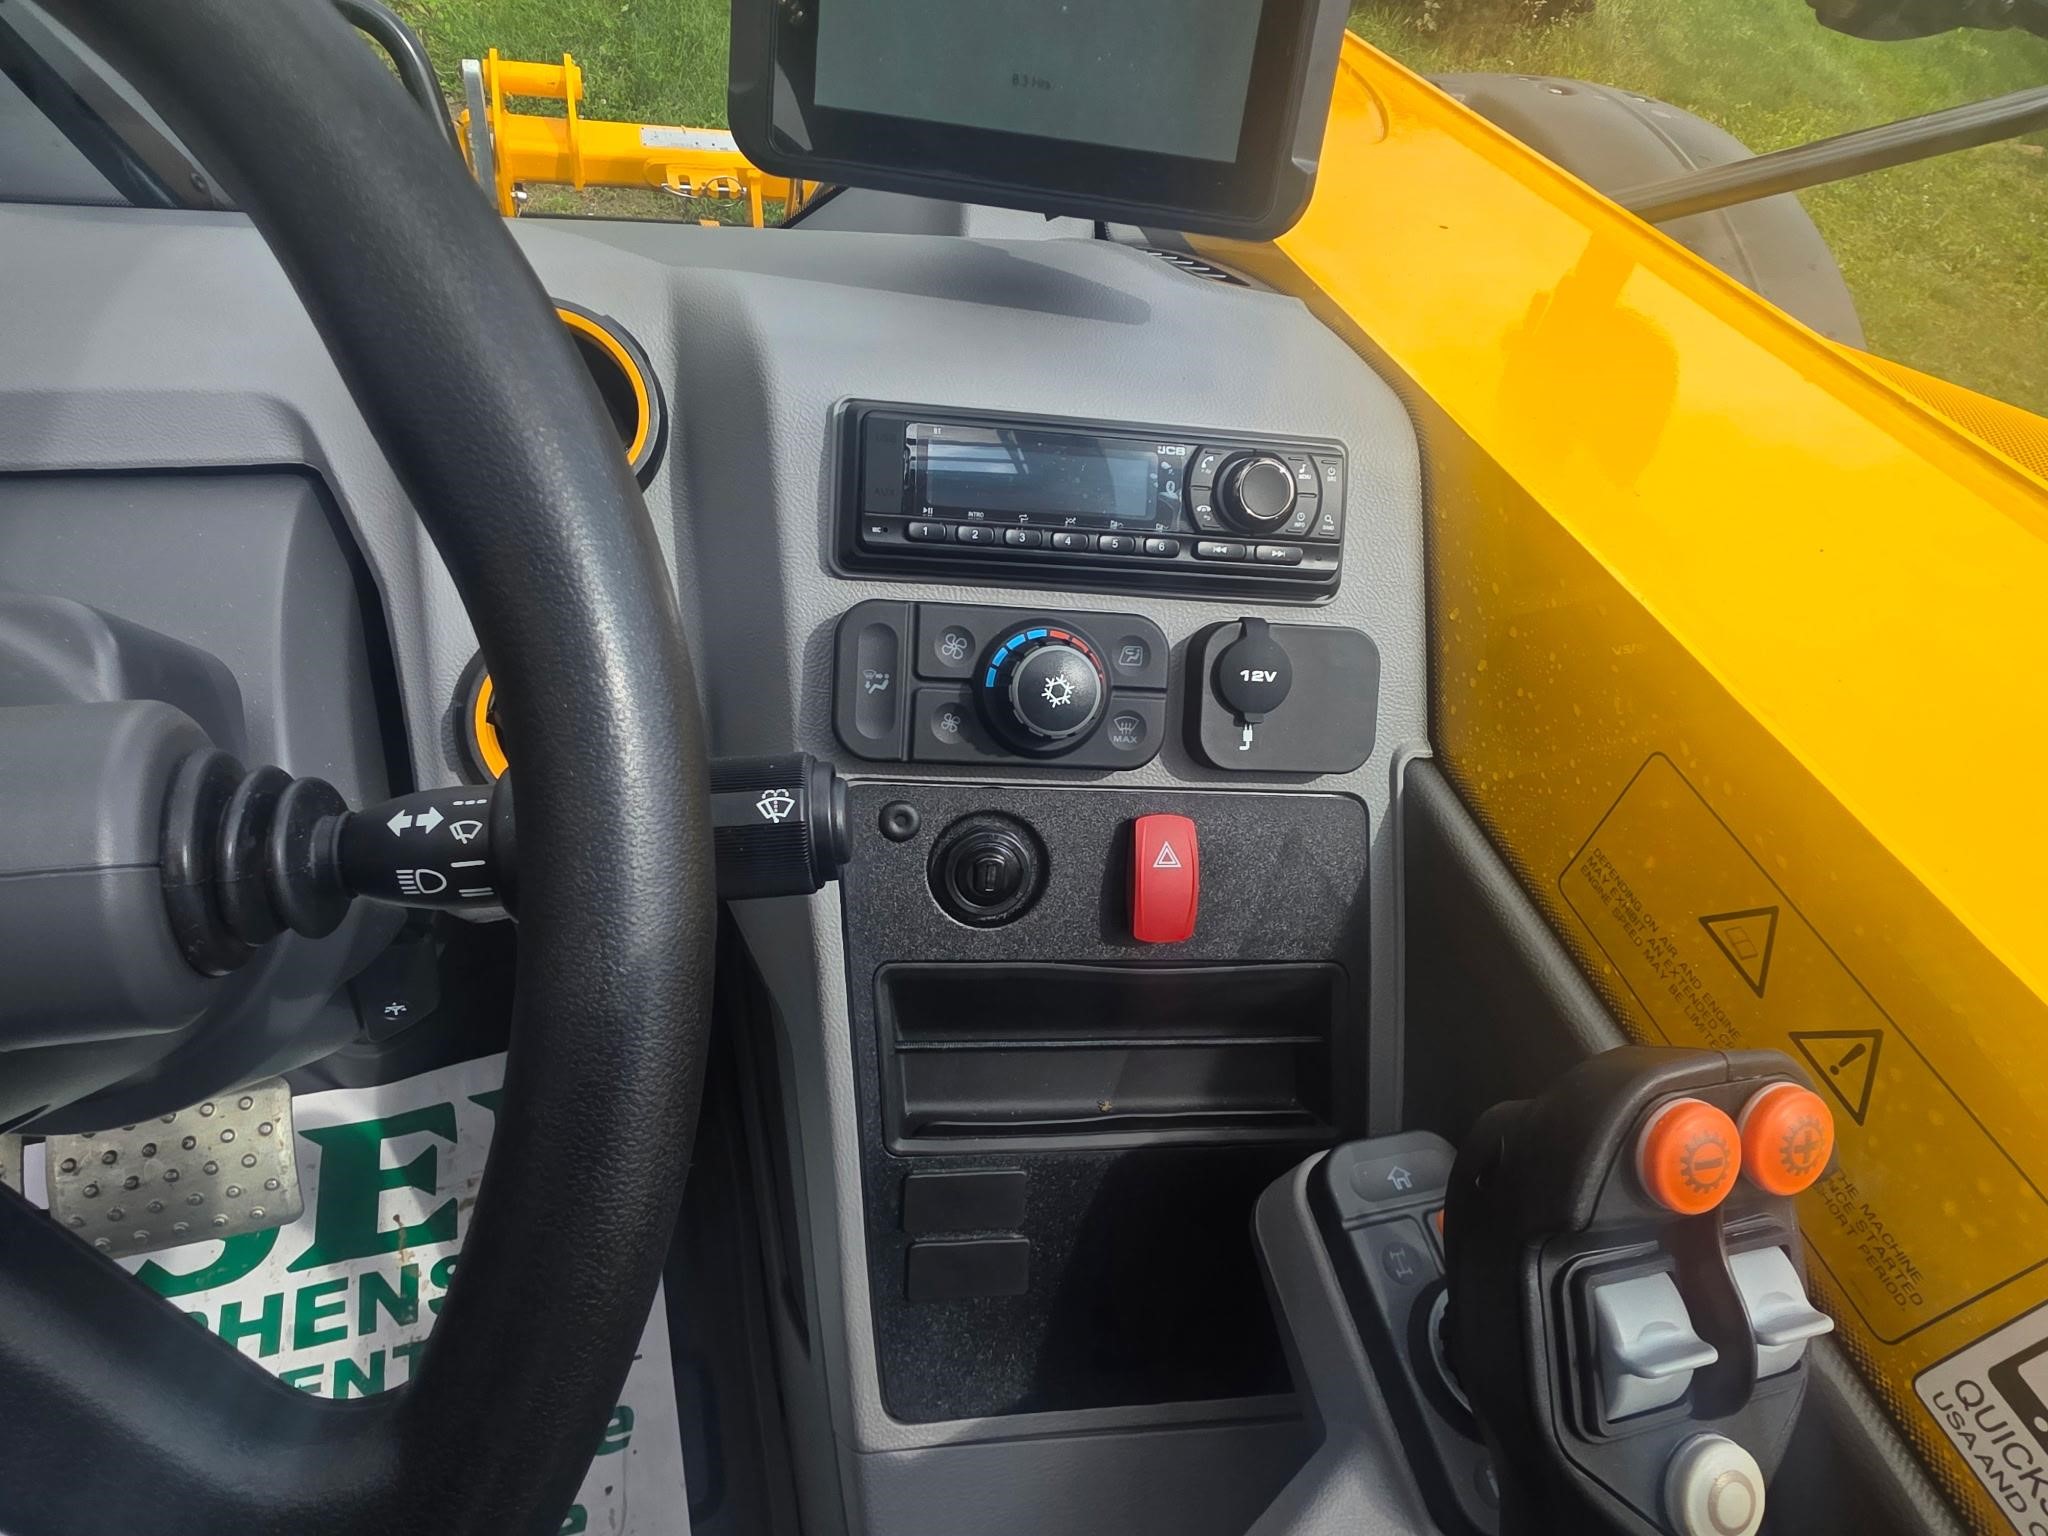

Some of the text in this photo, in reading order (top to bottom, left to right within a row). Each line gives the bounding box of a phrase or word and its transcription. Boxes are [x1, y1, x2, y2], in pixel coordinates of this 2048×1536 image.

[1157, 446, 1186, 456] JCB
[923, 526, 928, 536] 1
[972, 530, 979, 540] 2
[1019, 533, 1026, 542] 3
[1065, 536, 1071, 546] 4
[1112, 538, 1119, 548] 5
[1158, 542, 1165, 551] 6
[1239, 670, 1277, 682] 12V
[1113, 736, 1137, 744] MAX
[1587, 856, 1610, 884] MAY
[1610, 886, 1646, 931] EXHIBIT
[1648, 938, 1664, 957] AN
[1663, 959, 1717, 1030] EXTENDED
[1593, 848, 1742, 1041] DEPENDING ON AIR AND ENGINE
[1580, 864, 1720, 1050] ENGINE SPEED MAY BE LIMITE
[1860, 1203, 1924, 1284] MACHINE
[1855, 1219, 1924, 1306] STARTED
[1932, 1390, 2028, 1513] USA AND
